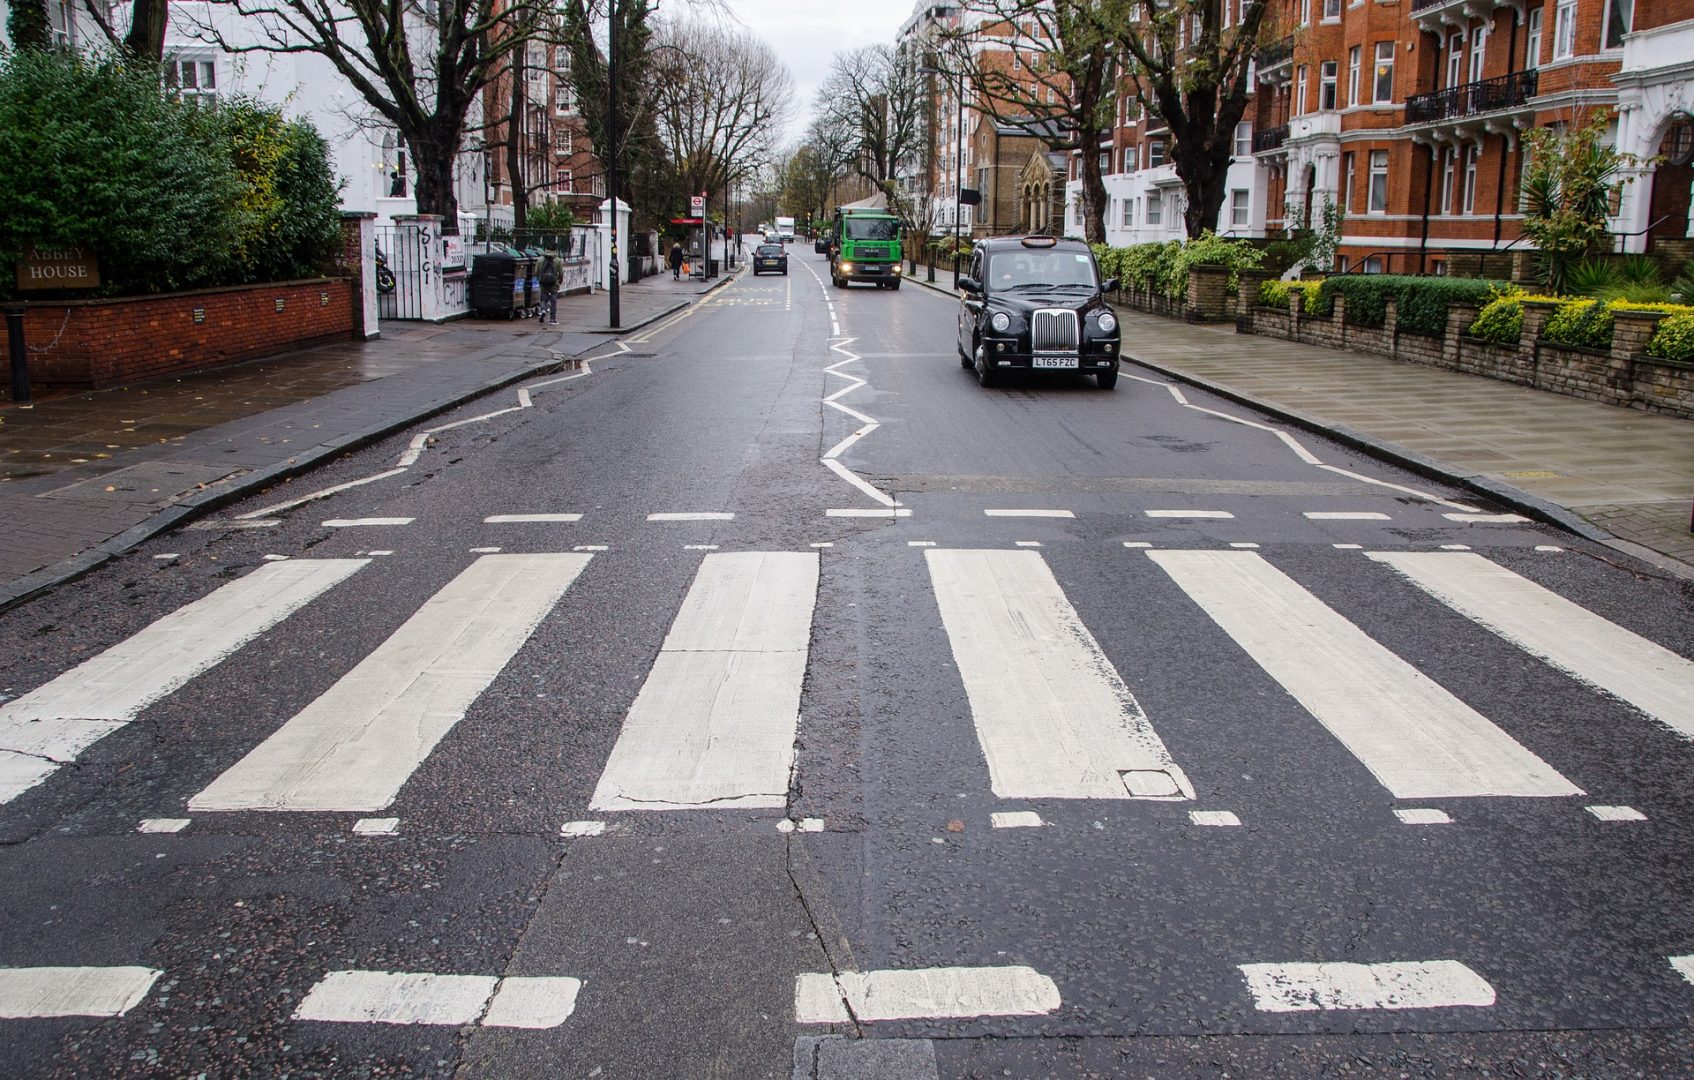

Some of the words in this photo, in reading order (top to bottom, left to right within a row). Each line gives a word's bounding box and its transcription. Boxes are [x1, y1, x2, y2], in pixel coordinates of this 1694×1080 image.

[29, 265, 88, 278] HOUSE
[1035, 358, 1058, 367] LT65
[1059, 358, 1076, 367] FZC
